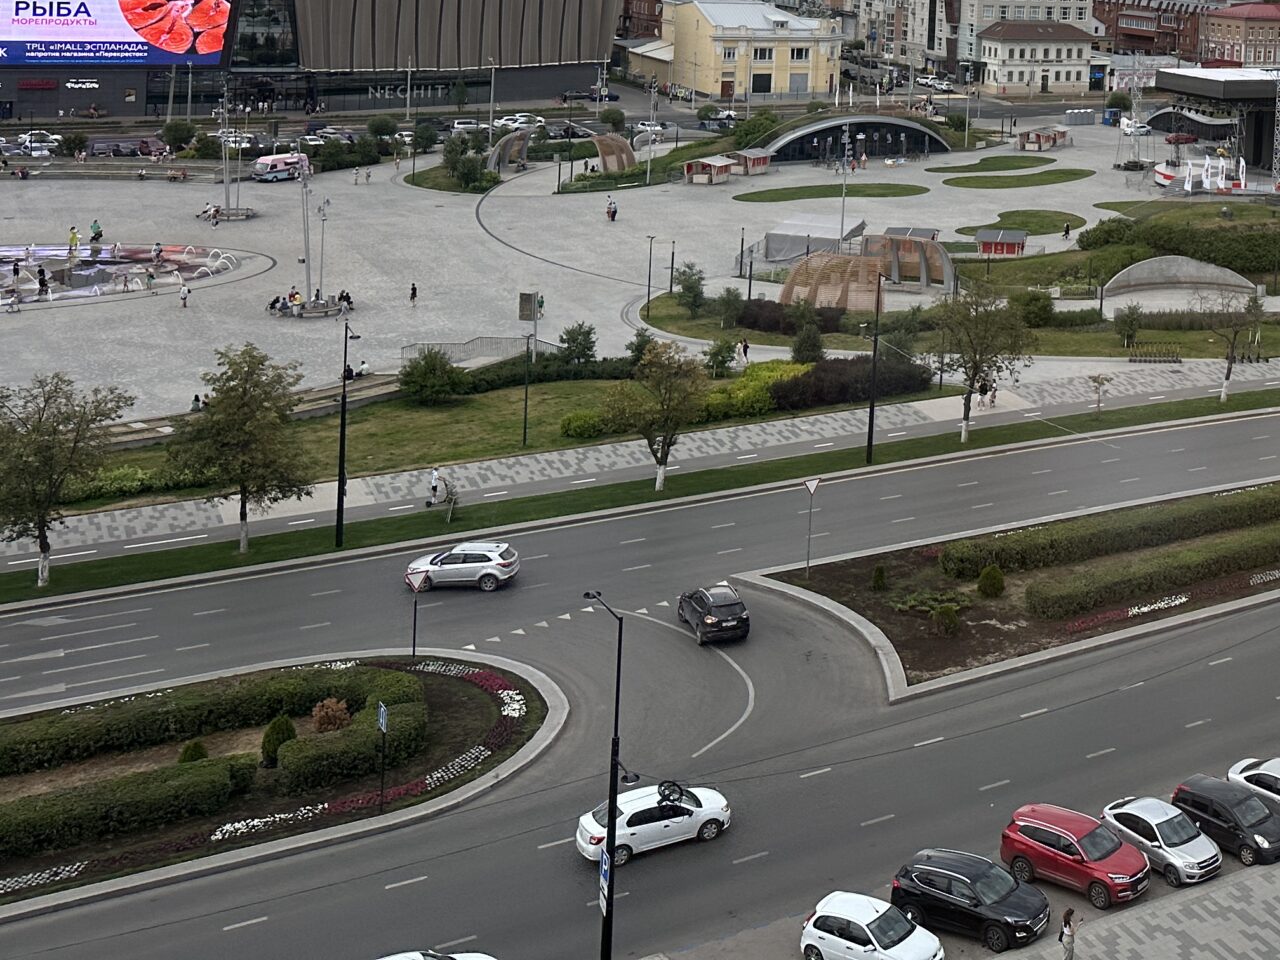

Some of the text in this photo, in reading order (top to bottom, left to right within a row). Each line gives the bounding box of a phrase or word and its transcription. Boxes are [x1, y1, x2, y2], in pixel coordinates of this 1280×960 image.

[15, 1, 92, 17] РЫБА
[11, 18, 97, 26] МОРЕПРОДУКТЫ
[25, 43, 46, 51] ТРЦ
[84, 43, 149, 51] ЭСПЛАНАДА»
